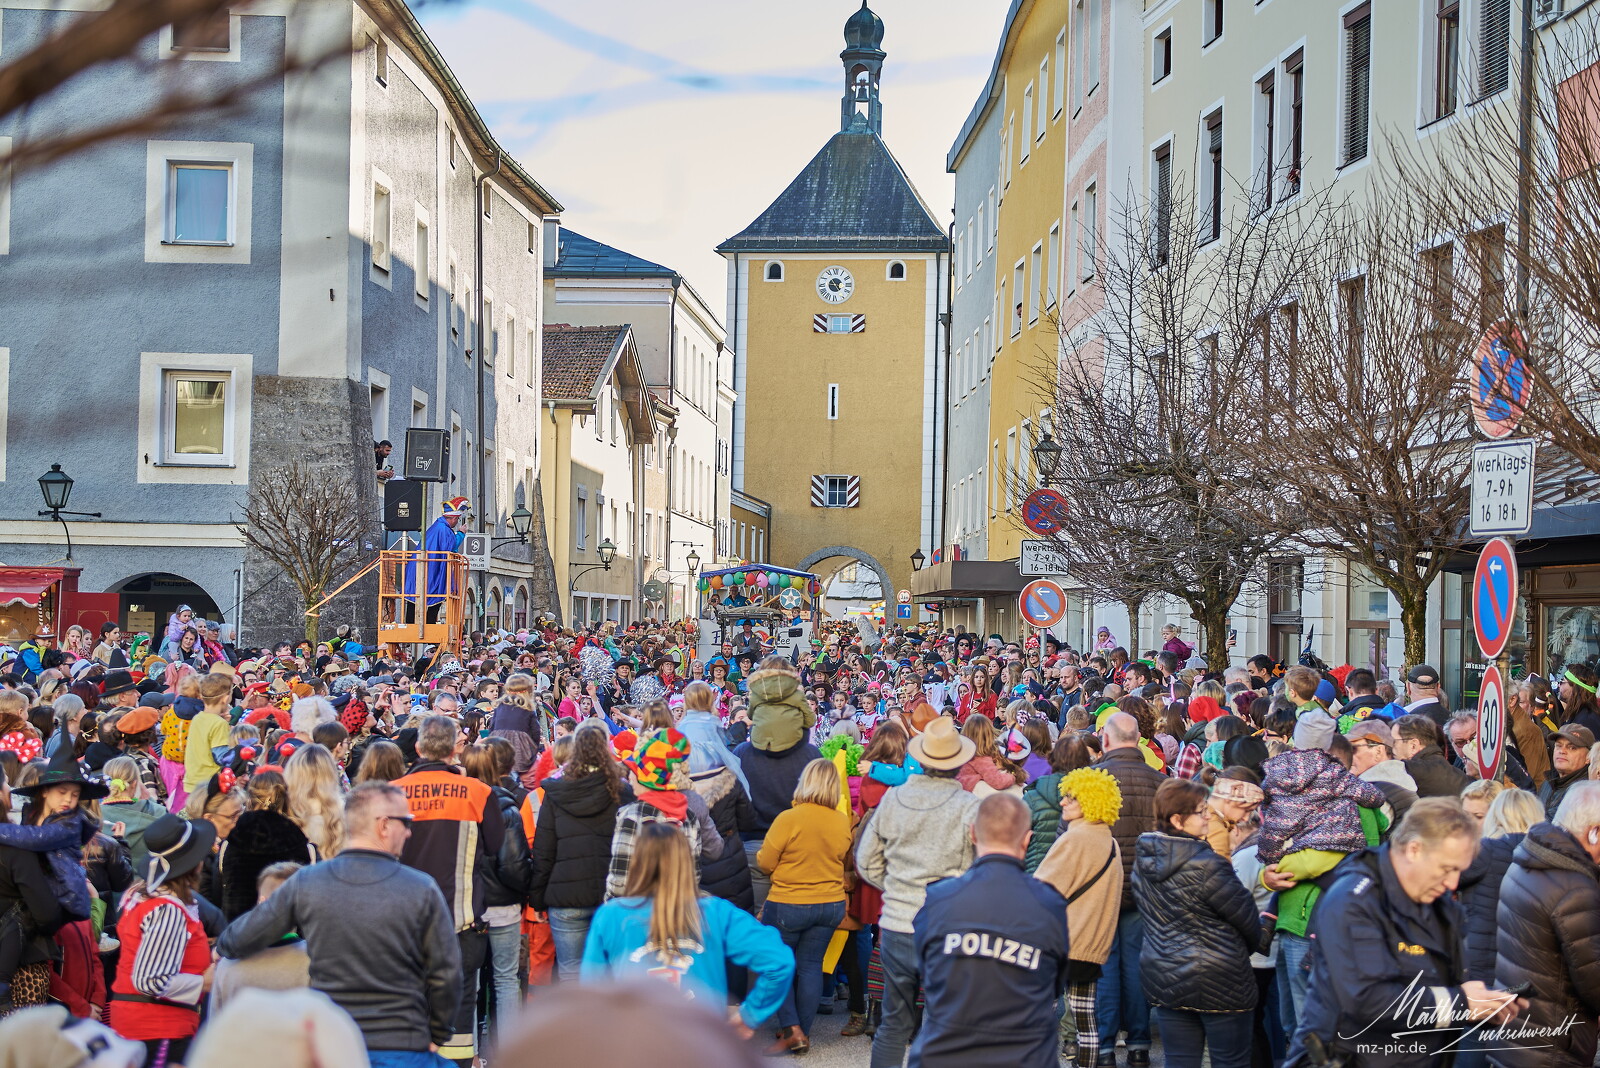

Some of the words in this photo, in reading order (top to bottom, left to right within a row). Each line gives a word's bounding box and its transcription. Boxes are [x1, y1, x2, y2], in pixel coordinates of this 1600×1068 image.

[1477, 454, 1527, 475] werktags
[1486, 478, 1506, 498] 7-9
[1508, 479, 1513, 496] h
[1511, 503, 1517, 521] h
[1025, 545, 1061, 553] werkta
[1481, 699, 1498, 751] 30
[403, 783, 468, 799] UERWEHR
[411, 799, 445, 811] LAUFEN
[943, 932, 1042, 970] POLIZEI
